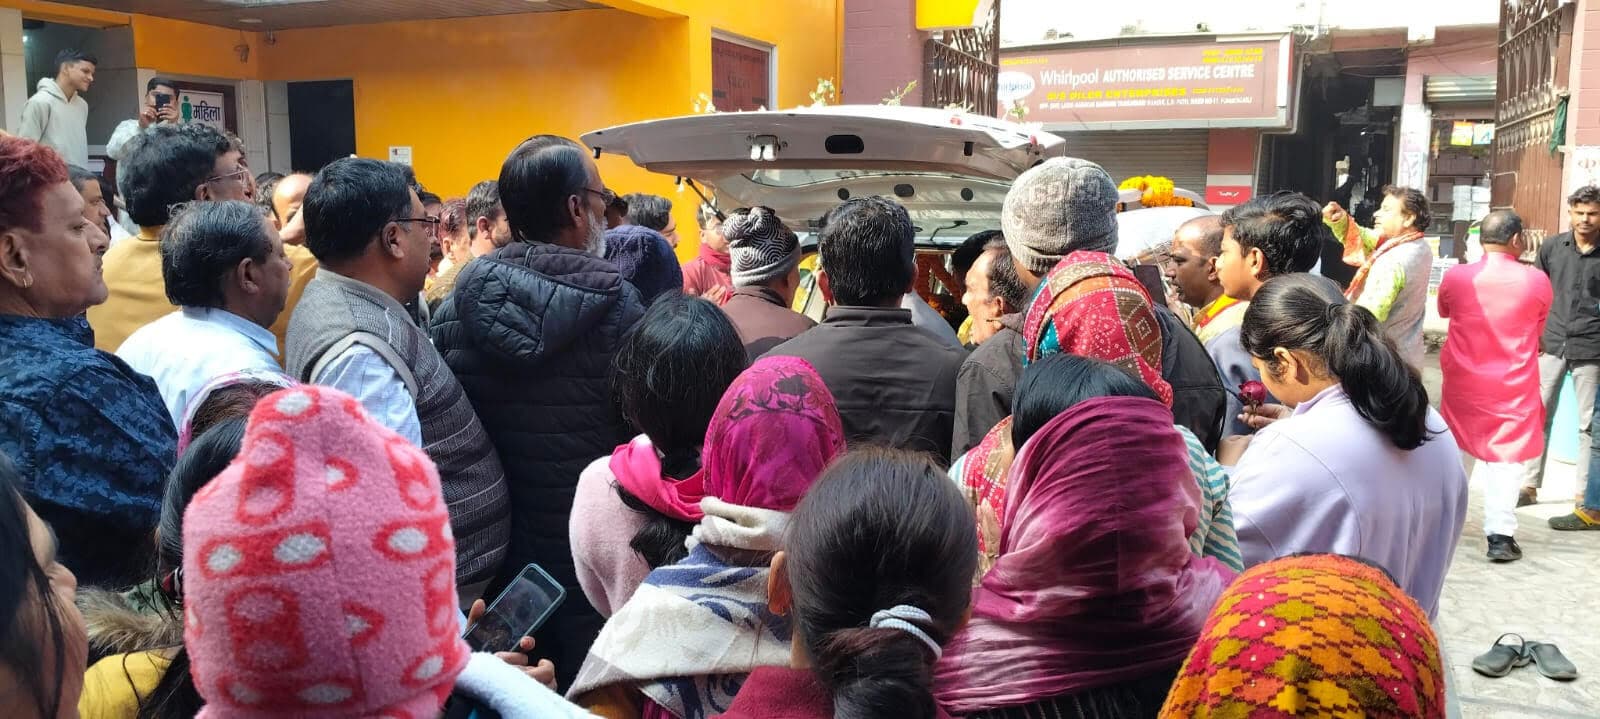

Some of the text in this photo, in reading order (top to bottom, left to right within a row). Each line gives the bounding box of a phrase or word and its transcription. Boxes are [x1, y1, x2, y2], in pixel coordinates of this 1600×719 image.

[1040, 64, 1255, 89] Whirlpool AUTHORISED SERVICE CENTRE
[193, 100, 220, 121] महिला
